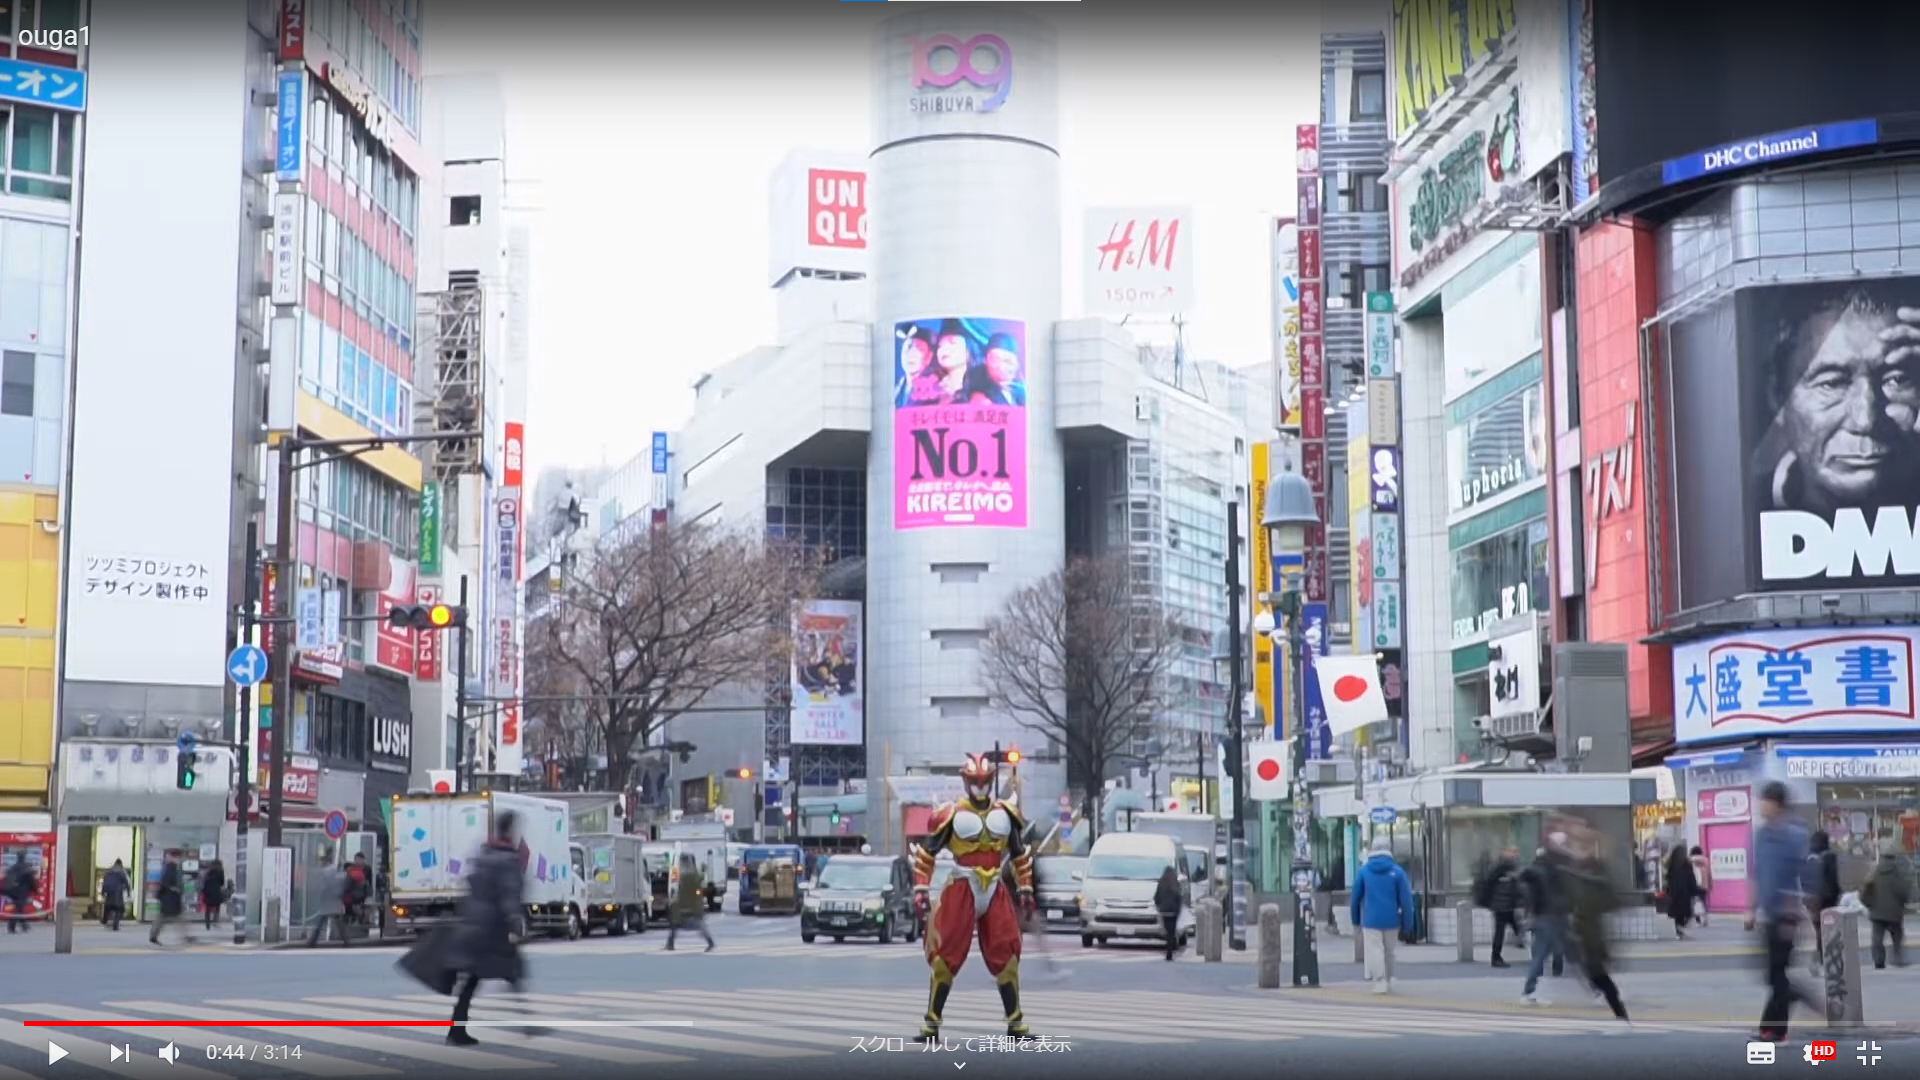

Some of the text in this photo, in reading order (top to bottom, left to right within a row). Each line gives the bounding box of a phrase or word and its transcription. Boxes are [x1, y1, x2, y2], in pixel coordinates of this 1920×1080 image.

[904, 33, 1012, 112] 109
[910, 97, 974, 112] SHIBUYA
[1704, 131, 1818, 170] DHC Channel
[279, 203, 292, 295] 渋谷駅前ビル
[1098, 218, 1178, 271] H&M
[910, 427, 1010, 479] No.1
[907, 492, 1013, 514] KIREIMO
[1585, 400, 1636, 590] クスリ
[1760, 505, 1920, 580] DM
[86, 578, 208, 600] デザイン製作中
[87, 556, 208, 577] ツツミプロジェクト
[1685, 646, 1898, 718] 大盛堂書
[373, 716, 410, 758] LUSH
[1788, 760, 1808, 777] ONE
